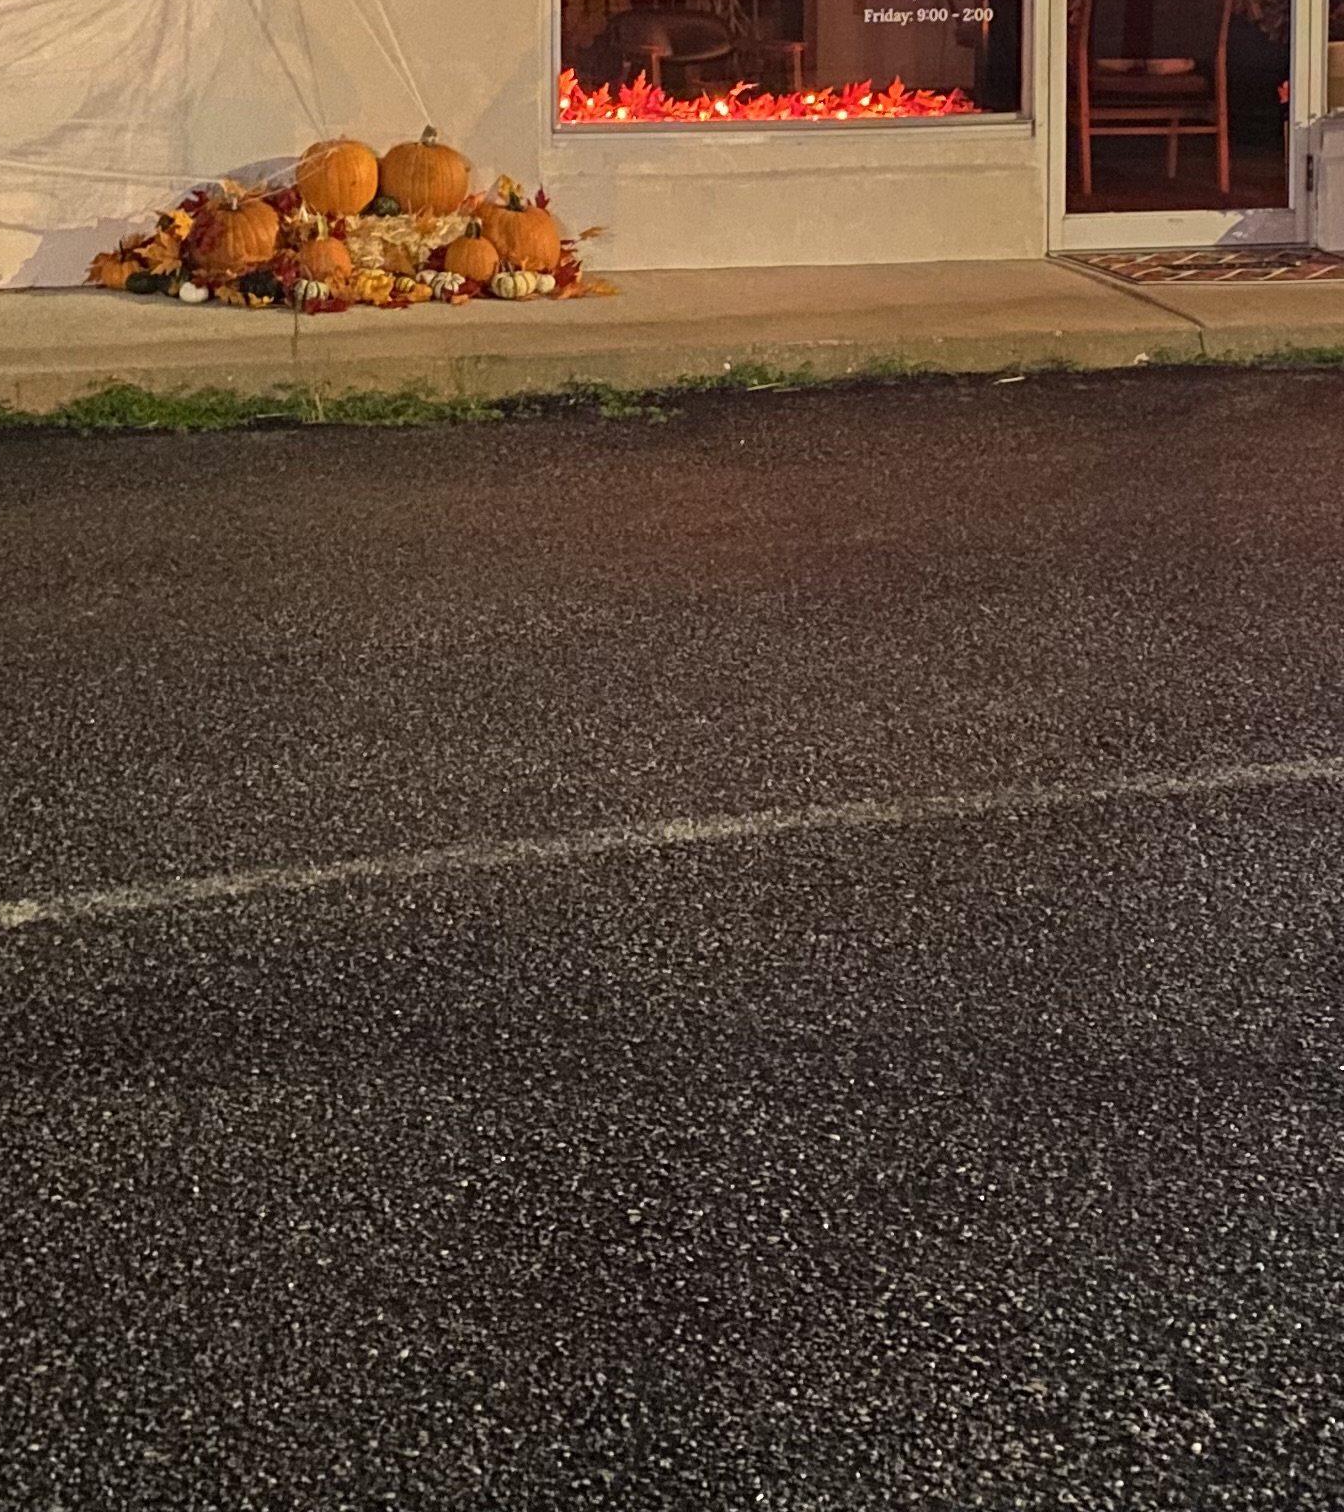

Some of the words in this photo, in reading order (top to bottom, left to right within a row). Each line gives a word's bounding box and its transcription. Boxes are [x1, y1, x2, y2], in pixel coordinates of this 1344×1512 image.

[864, 9, 913, 25] Friday:
[917, 9, 948, 22] 9:00
[963, 9, 993, 22] 2:00
